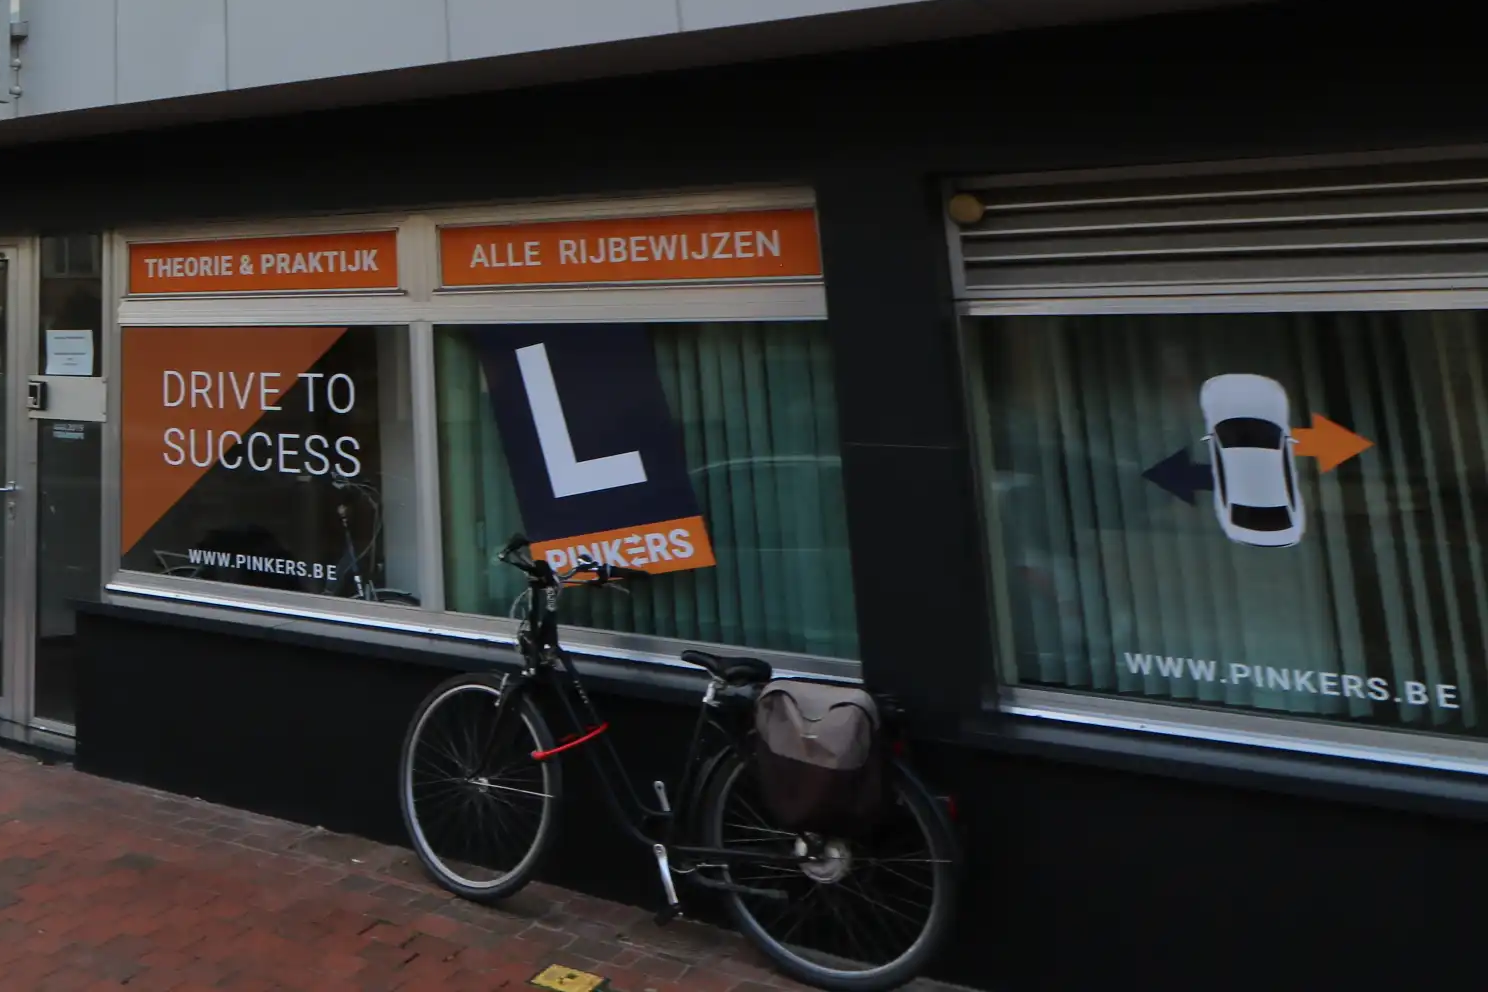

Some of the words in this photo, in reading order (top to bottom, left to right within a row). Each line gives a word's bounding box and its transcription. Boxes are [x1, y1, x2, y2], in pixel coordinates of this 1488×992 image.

[144, 255, 233, 278] THEORIE
[239, 254, 254, 275] &
[261, 249, 379, 275] PRAKTIJK
[469, 241, 542, 268] ALLE
[559, 230, 781, 265] RIJBEWIJZEN
[163, 370, 283, 411] DRIVE
[297, 372, 355, 414] TO
[515, 342, 648, 498] L
[163, 427, 361, 478] SUCCESS
[188, 548, 338, 581] WWW.PINKERS.BE
[1124, 652, 1460, 709] WWW.PINKERS.BE
